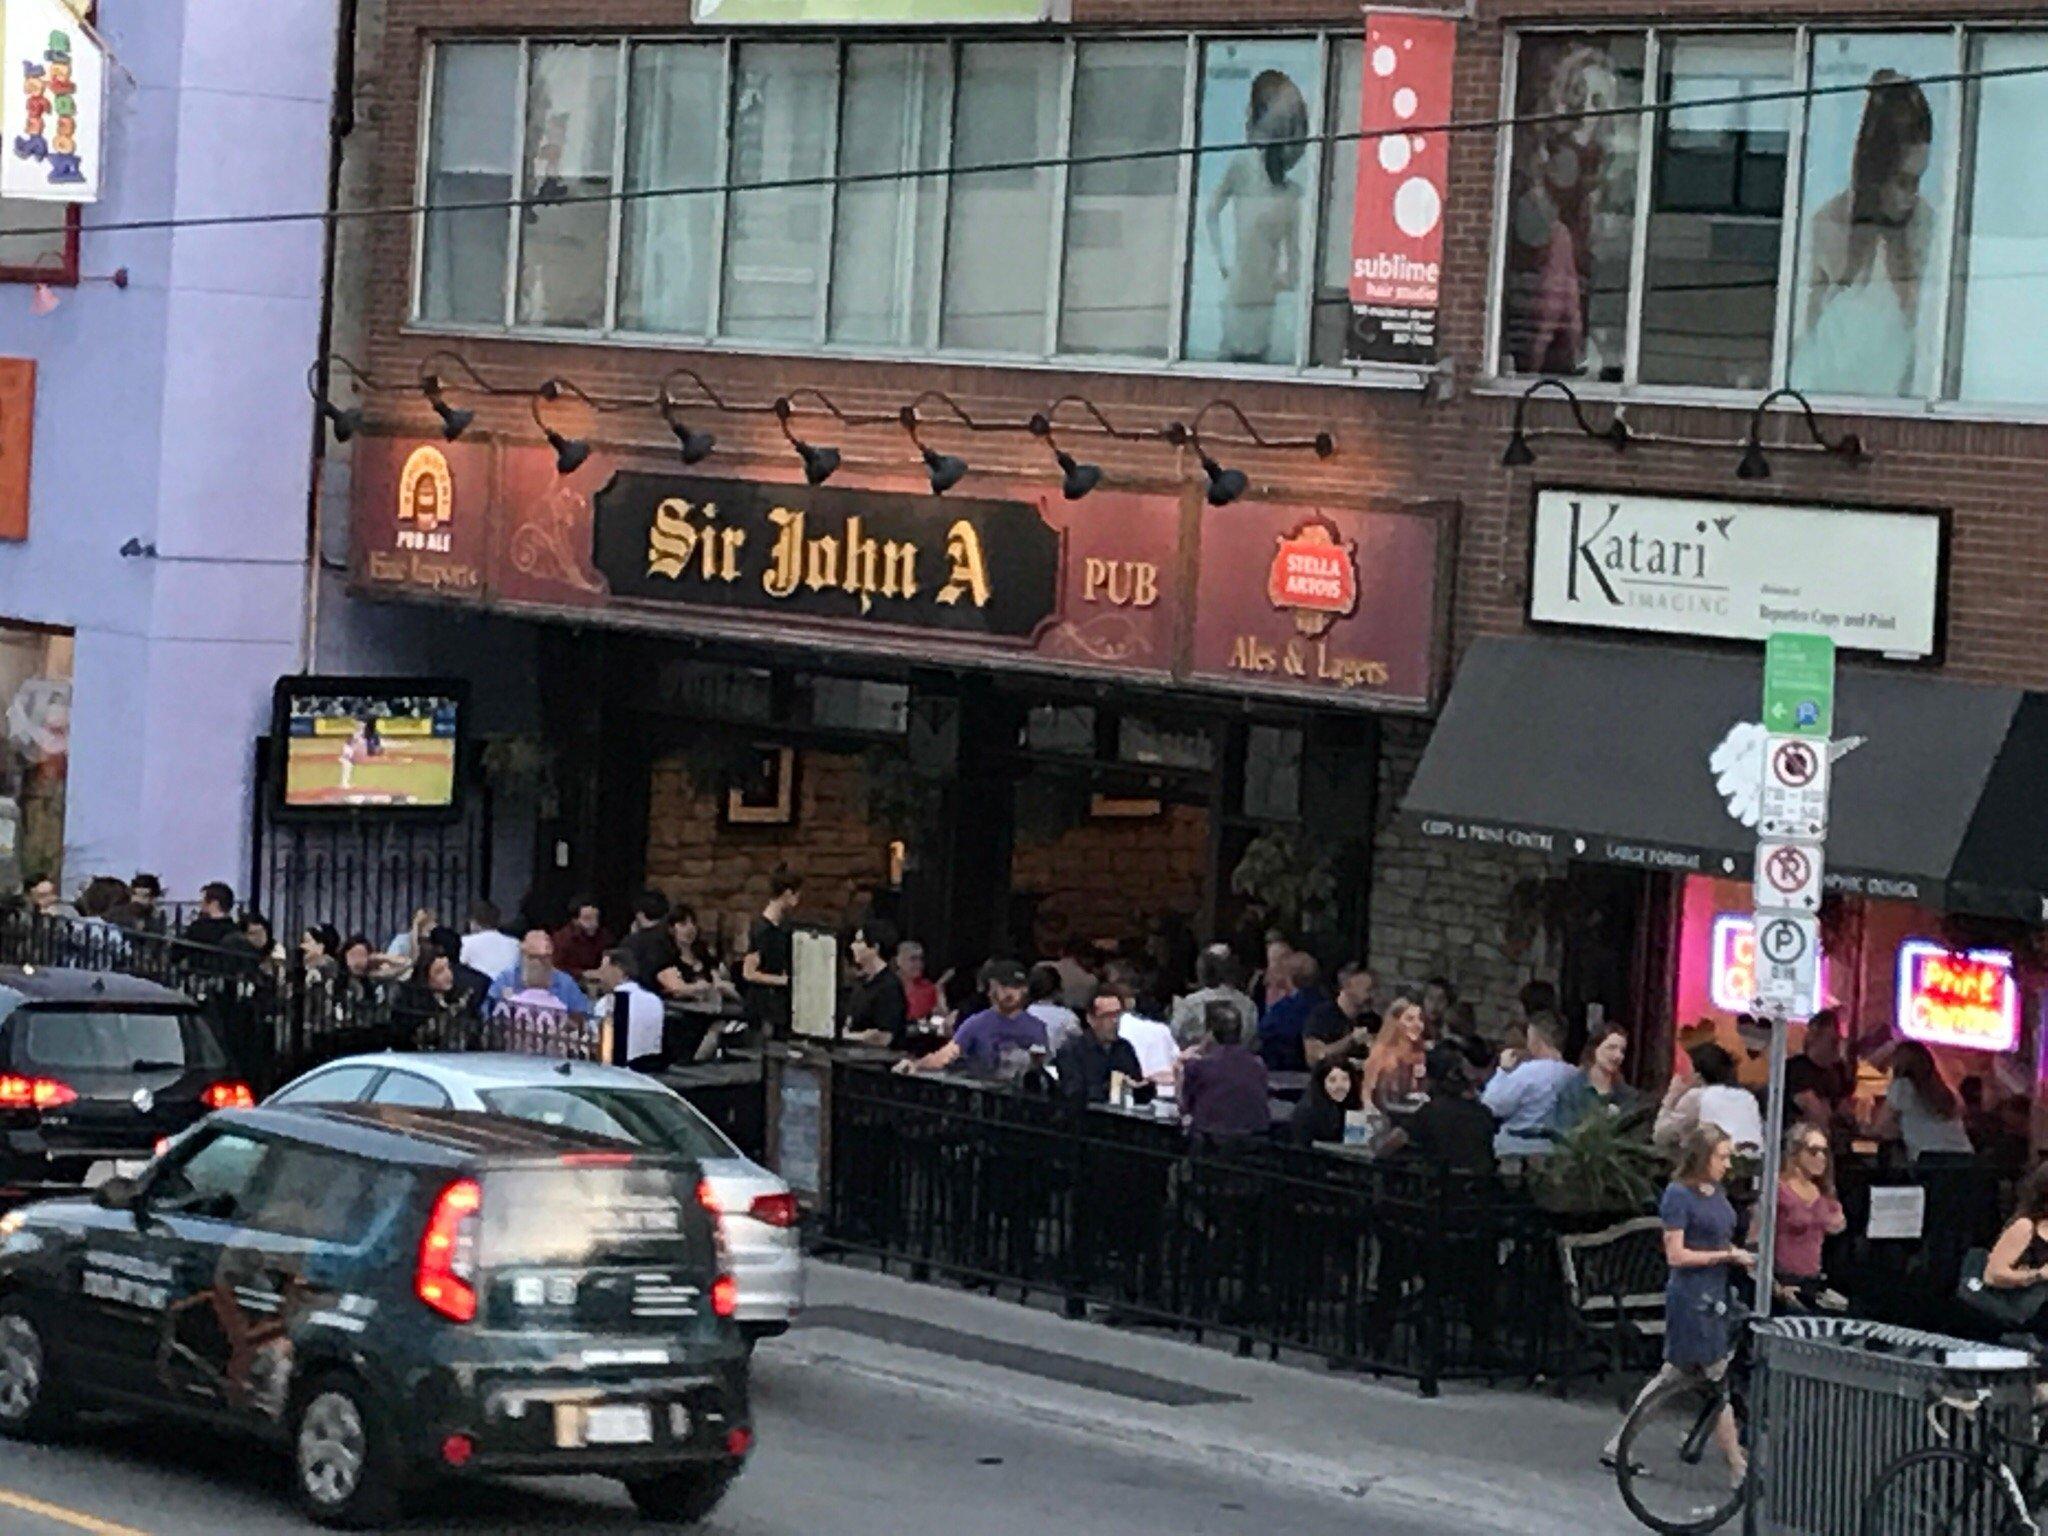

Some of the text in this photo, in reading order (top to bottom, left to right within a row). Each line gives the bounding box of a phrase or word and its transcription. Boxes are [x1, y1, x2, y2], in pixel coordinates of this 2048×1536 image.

[1353, 252, 1440, 283] sublime
[647, 498, 991, 615] Sir John A
[1286, 553, 1341, 577] STELLA
[1568, 502, 1707, 606] Katari
[1083, 558, 1159, 606] PUB
[1285, 575, 1341, 599] ARTOIS
[1228, 636, 1277, 672] Ales
[1283, 640, 1307, 676] &
[1925, 960, 1995, 1003] Print
